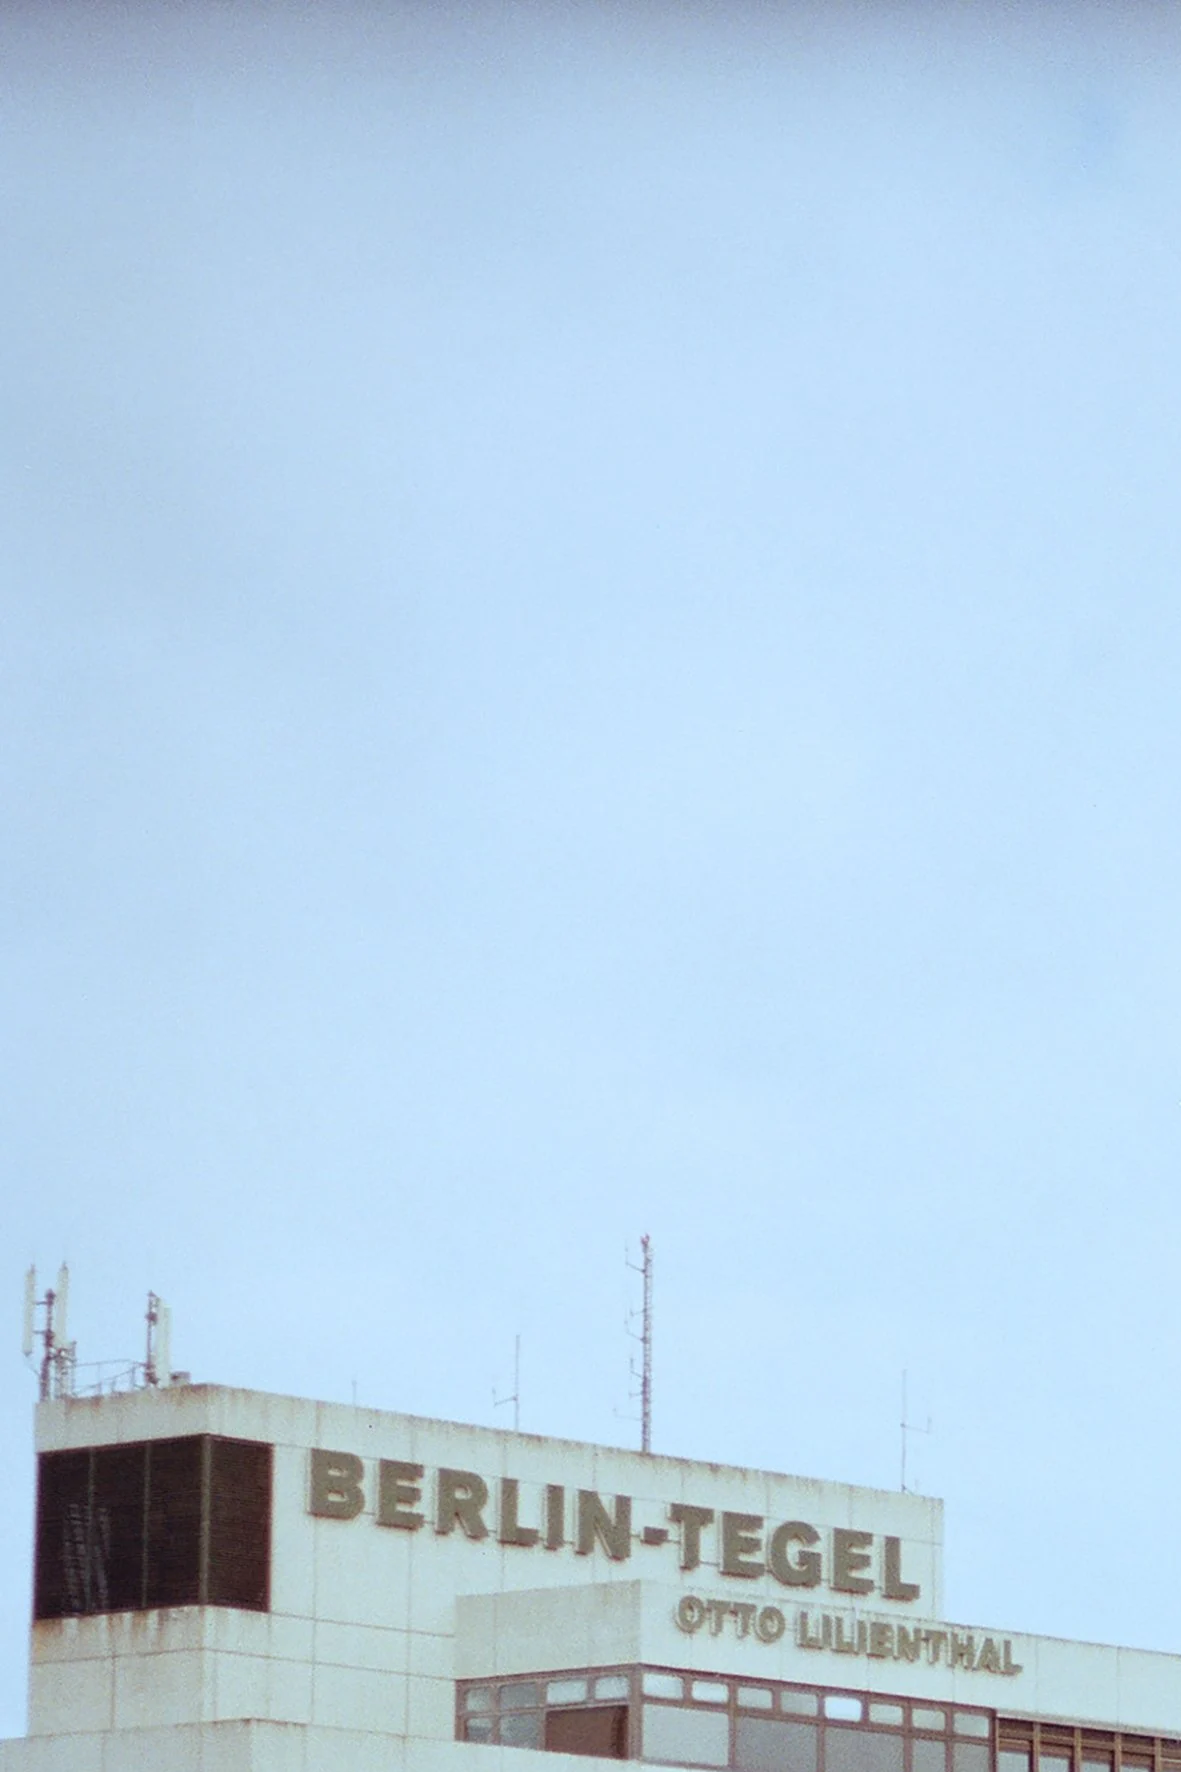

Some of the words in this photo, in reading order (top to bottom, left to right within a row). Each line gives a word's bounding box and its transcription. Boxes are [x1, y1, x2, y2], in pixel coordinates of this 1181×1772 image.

[308, 1447, 921, 1601] BERLIN-TEGEL
[675, 1594, 786, 1644] OTTO
[796, 1610, 1024, 1676] LILIENTHAL
